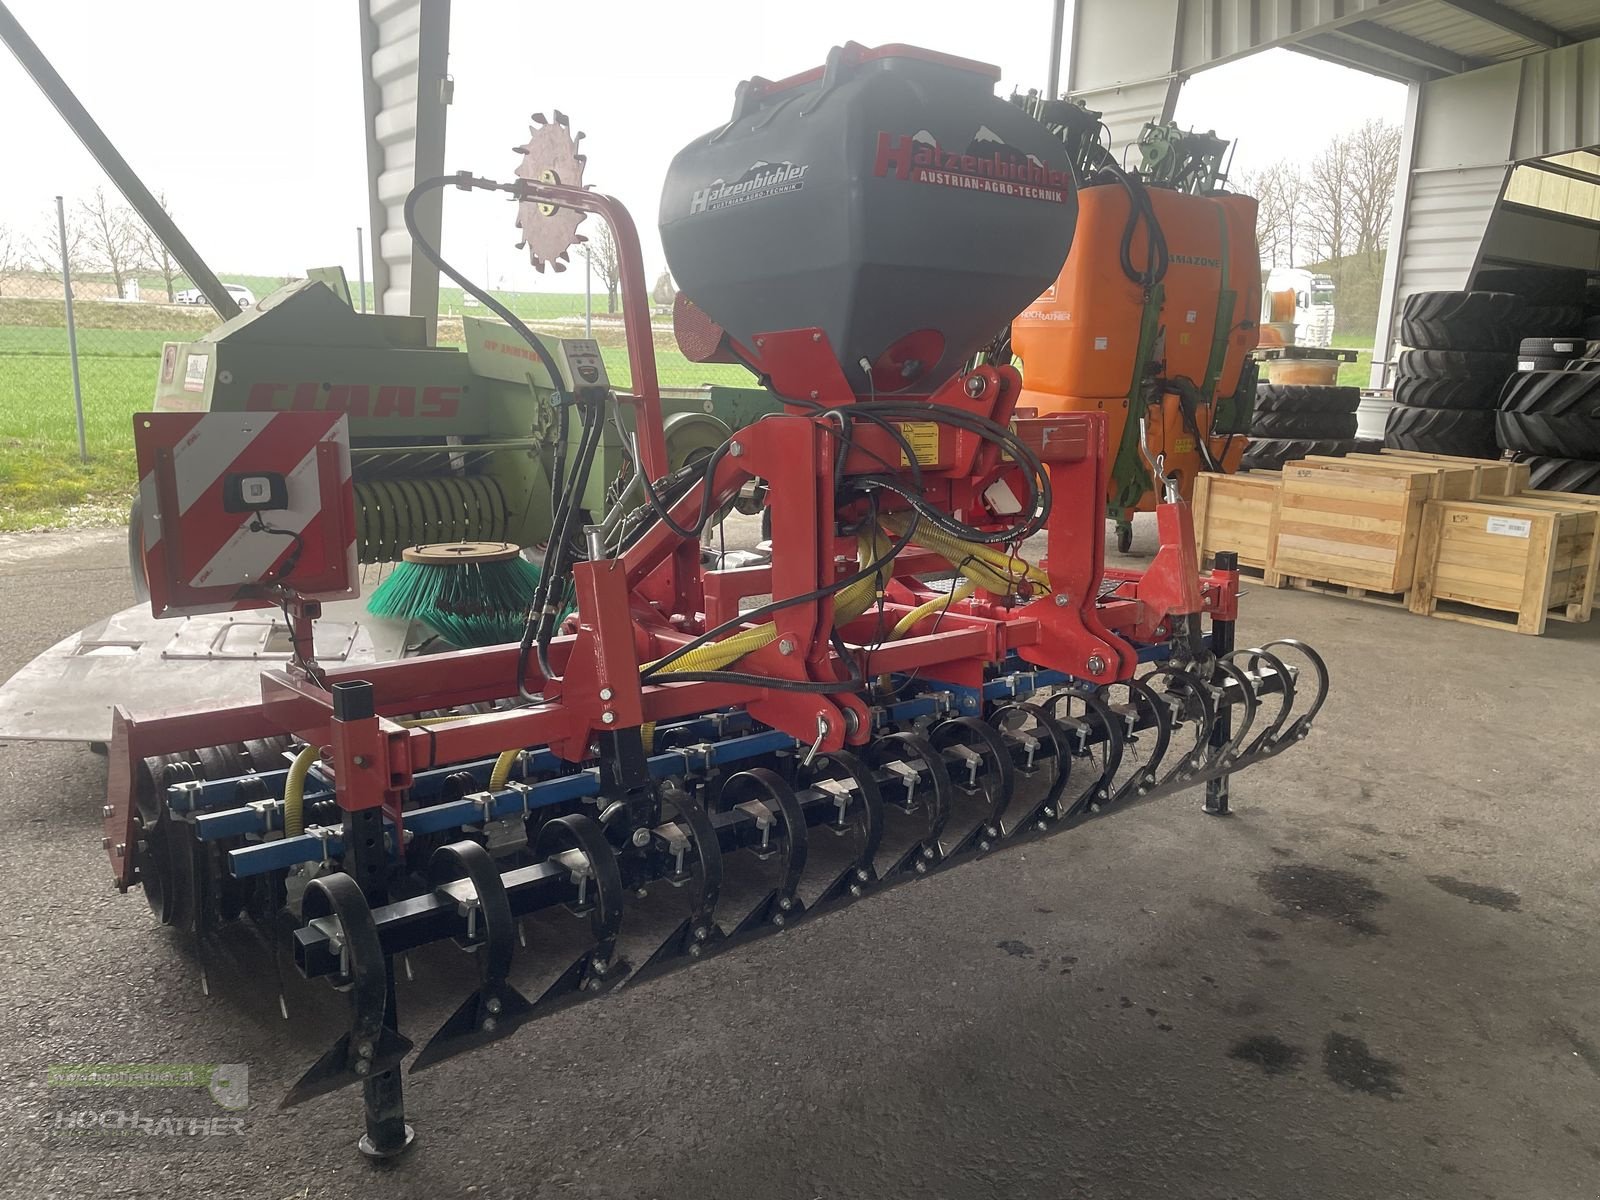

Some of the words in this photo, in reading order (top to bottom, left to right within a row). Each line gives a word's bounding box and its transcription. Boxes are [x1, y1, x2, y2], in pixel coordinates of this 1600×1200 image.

[874, 131, 1071, 187] Hatzenbichler
[690, 164, 809, 216] Hatzenbichler
[919, 170, 1063, 202] AUSTRIAN-AGRO-TECHNIK
[247, 382, 463, 418] CLAAS
